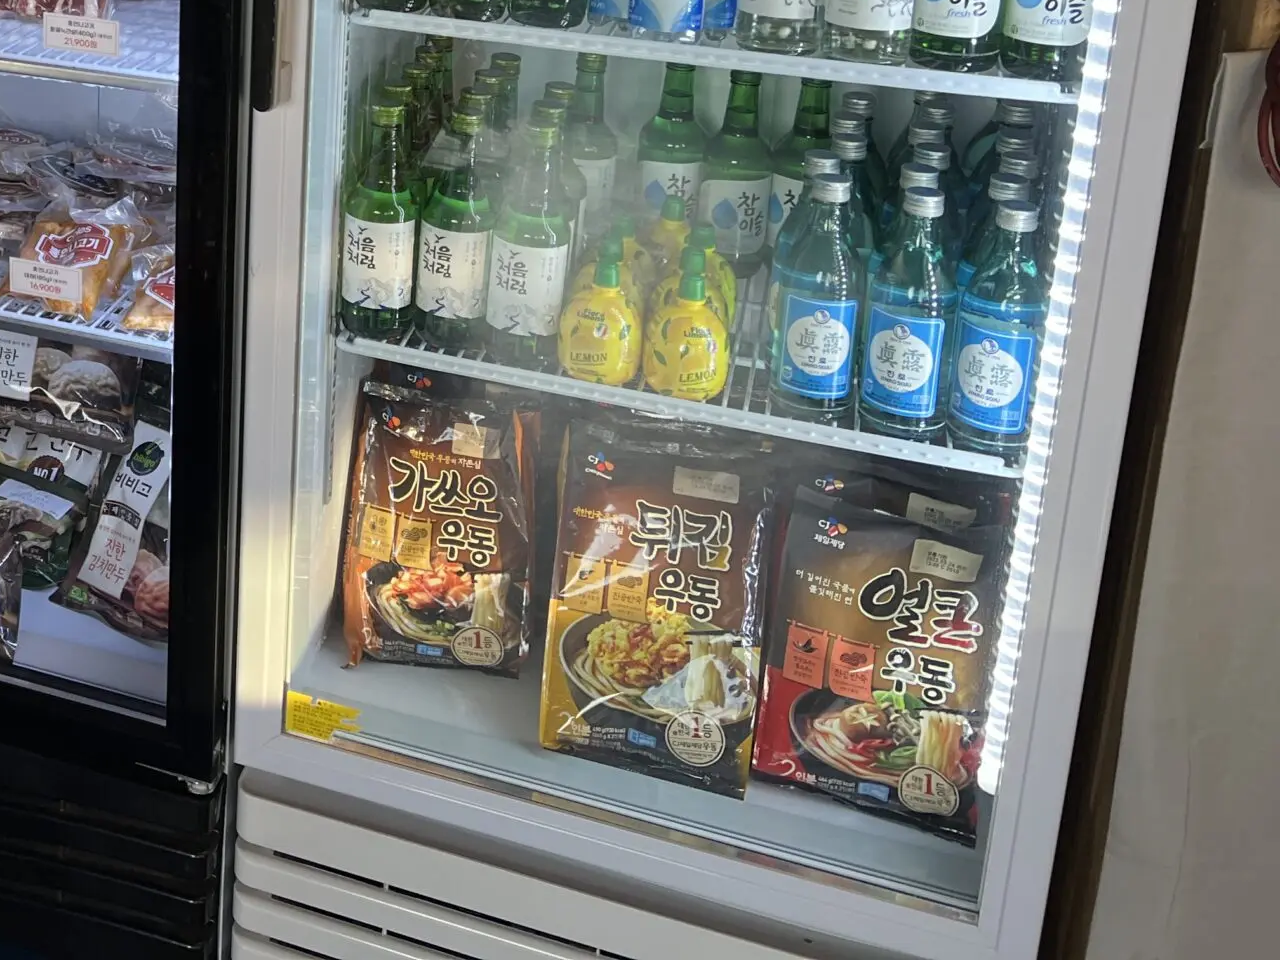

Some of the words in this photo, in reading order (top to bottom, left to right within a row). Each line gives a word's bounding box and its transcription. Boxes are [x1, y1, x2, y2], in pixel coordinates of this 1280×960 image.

[946, 7, 972, 19] fresh
[1041, 15, 1068, 27] fresh
[347, 232, 377, 253] 처음
[423, 240, 453, 263] 처음
[347, 249, 377, 270] 처럼
[422, 257, 452, 278] 처럼
[570, 352, 608, 362] LEMON
[679, 370, 718, 383] LEMON
[388, 456, 503, 523] 가쓰오
[815, 478, 827, 489] CJ
[818, 518, 831, 530] CJ
[436, 519, 498, 568] 우동
[628, 499, 733, 572] 튀김
[104, 538, 126, 561] 진한
[87, 554, 126, 584] 김치만두
[653, 564, 722, 623] 우동
[858, 567, 984, 654] 얼큰
[880, 647, 957, 705] 우동
